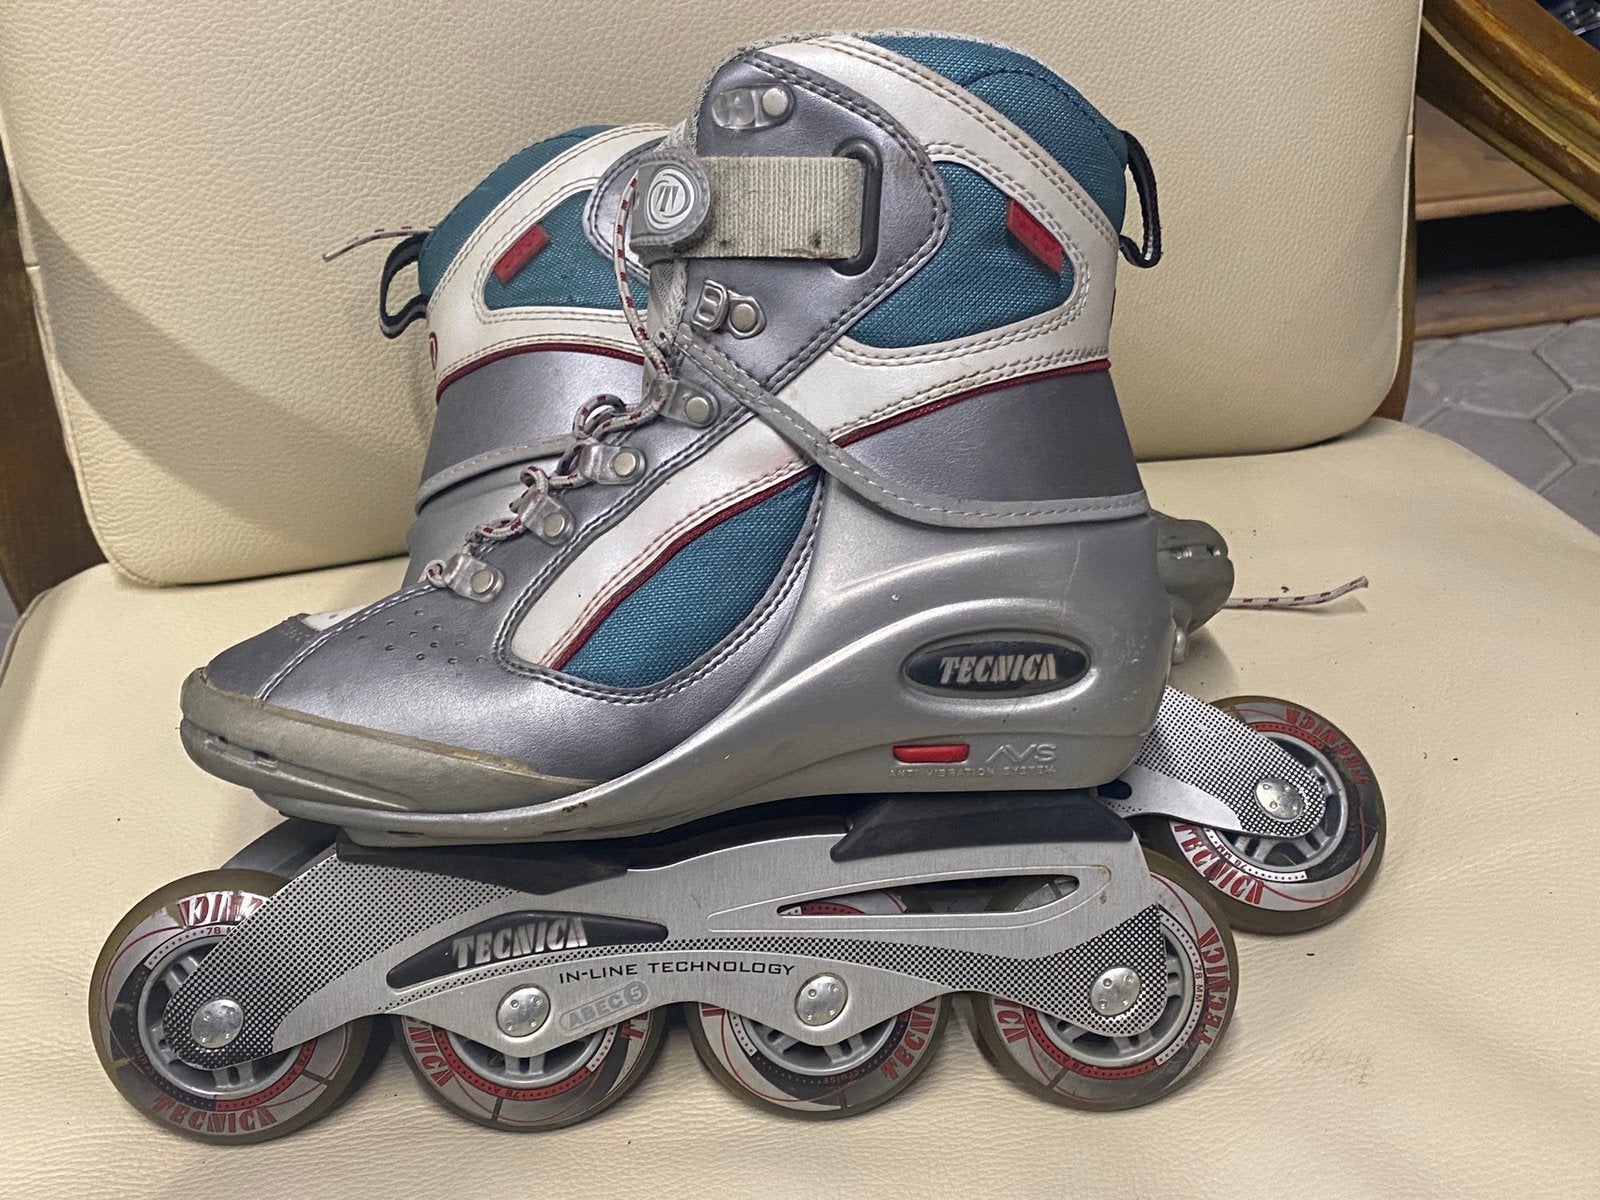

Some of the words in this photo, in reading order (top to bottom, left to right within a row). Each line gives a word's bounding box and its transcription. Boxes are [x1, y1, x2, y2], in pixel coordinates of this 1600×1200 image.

[939, 653, 1057, 684] TECNICA
[984, 743, 1057, 763] AVS
[1173, 823, 1264, 904] TECNICA
[176, 893, 263, 926] NICA
[452, 916, 588, 969] TECNICA
[559, 964, 638, 984] IN-LINE
[647, 961, 796, 976] TECHNOLOGY
[1195, 926, 1229, 1046] TECNICA
[568, 993, 623, 1029] ABEC
[406, 1020, 455, 1088] NICA
[880, 1001, 937, 1081] TECNI
[152, 1094, 278, 1133] TECNICA
